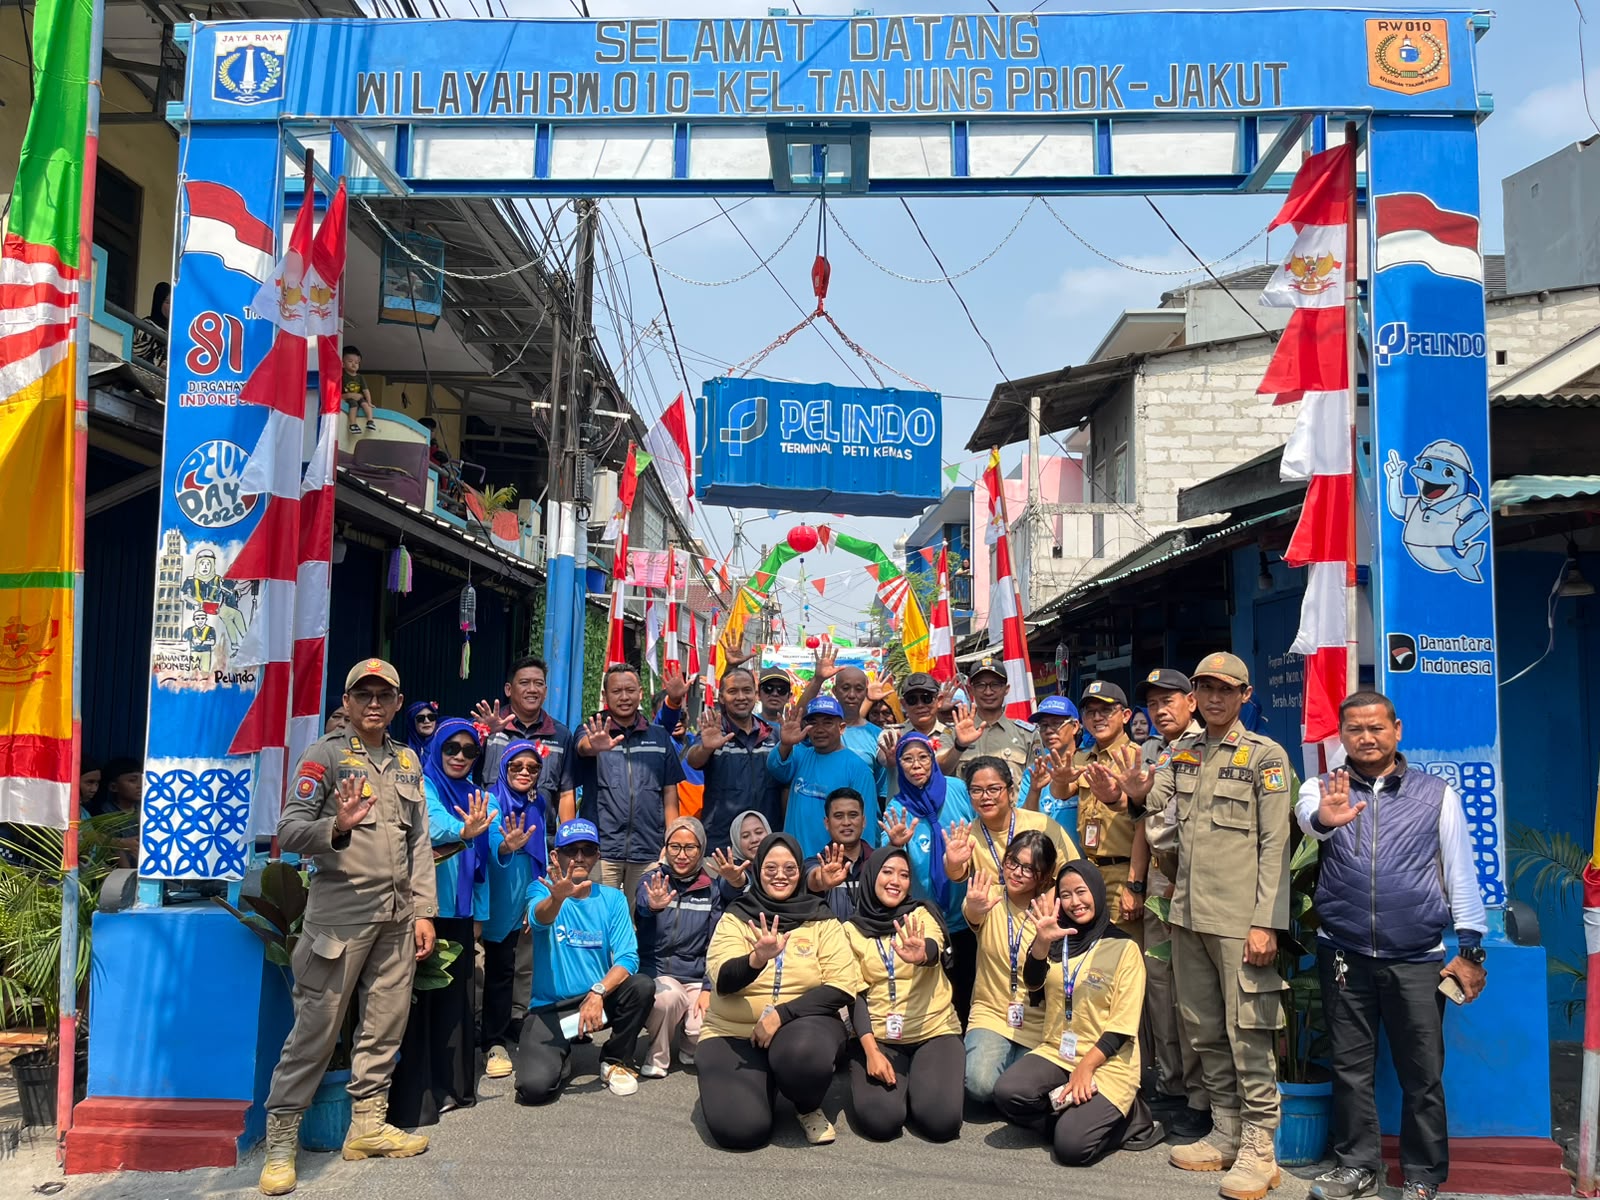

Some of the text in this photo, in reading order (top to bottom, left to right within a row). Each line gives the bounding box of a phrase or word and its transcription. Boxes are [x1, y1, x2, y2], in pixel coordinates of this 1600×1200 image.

[1378, 21, 1431, 32] RW 010
[222, 34, 283, 43] JAYA RAYA
[595, 15, 1040, 63] SELAMAT DATANG
[185, 310, 244, 376] 81
[1406, 332, 1487, 358] PELINDO
[187, 381, 247, 393] DIRGAHAY
[780, 399, 936, 446] PELINDO
[780, 442, 912, 460] TERMINAL PETI KEMAS
[177, 482, 240, 519] DAY
[197, 502, 245, 526] 2026
[1418, 634, 1494, 652] Danantara
[156, 654, 201, 665] DANANTARA
[1421, 657, 1493, 675] Indonesia
